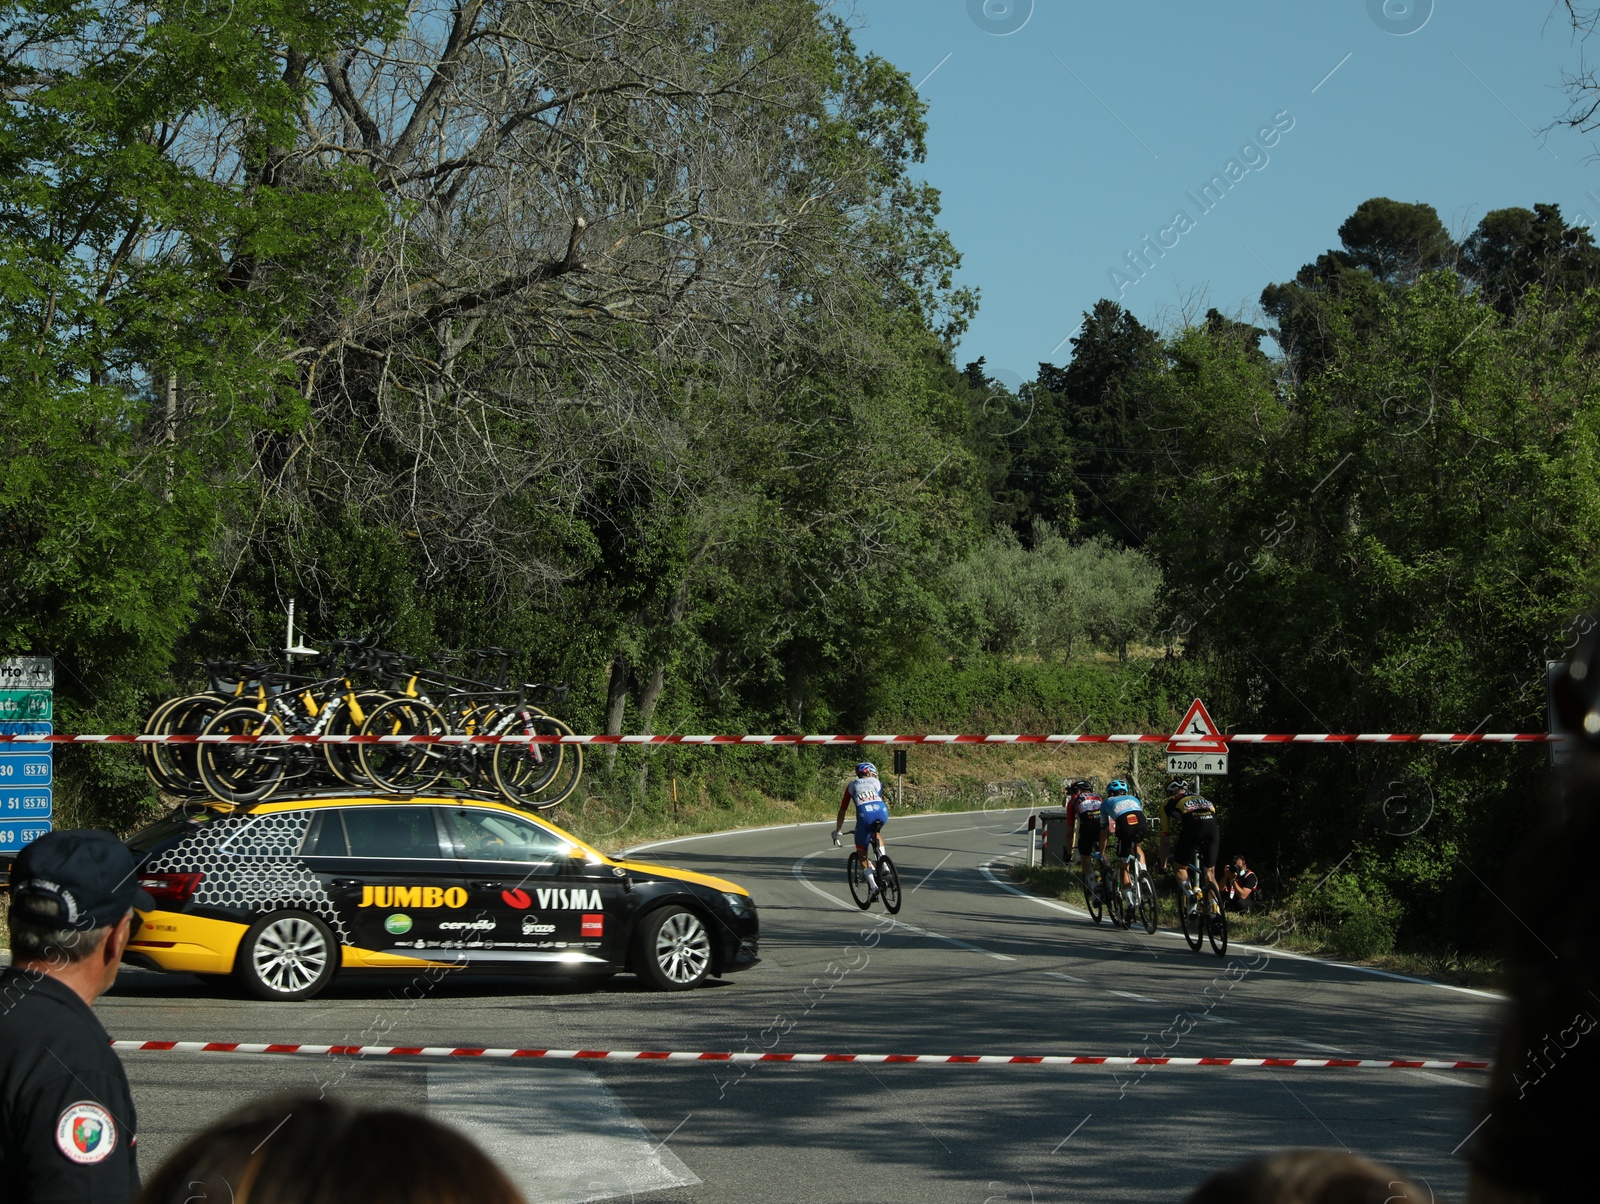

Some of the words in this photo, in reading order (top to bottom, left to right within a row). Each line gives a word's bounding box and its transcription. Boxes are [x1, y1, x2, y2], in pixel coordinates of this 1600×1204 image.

[2, 665, 22, 677] rto
[0, 764, 14, 777] 30
[25, 765, 36, 775] SS
[37, 765, 47, 775] 76
[1177, 761, 1197, 770] 2700
[8, 797, 19, 810] 51
[25, 798, 35, 808] SS
[36, 798, 46, 808] 76
[0, 830, 14, 843] 69
[23, 831, 34, 841] SS
[358, 885, 468, 909] JUMBO
[536, 888, 603, 910] VISMA
[521, 923, 556, 936] graze
